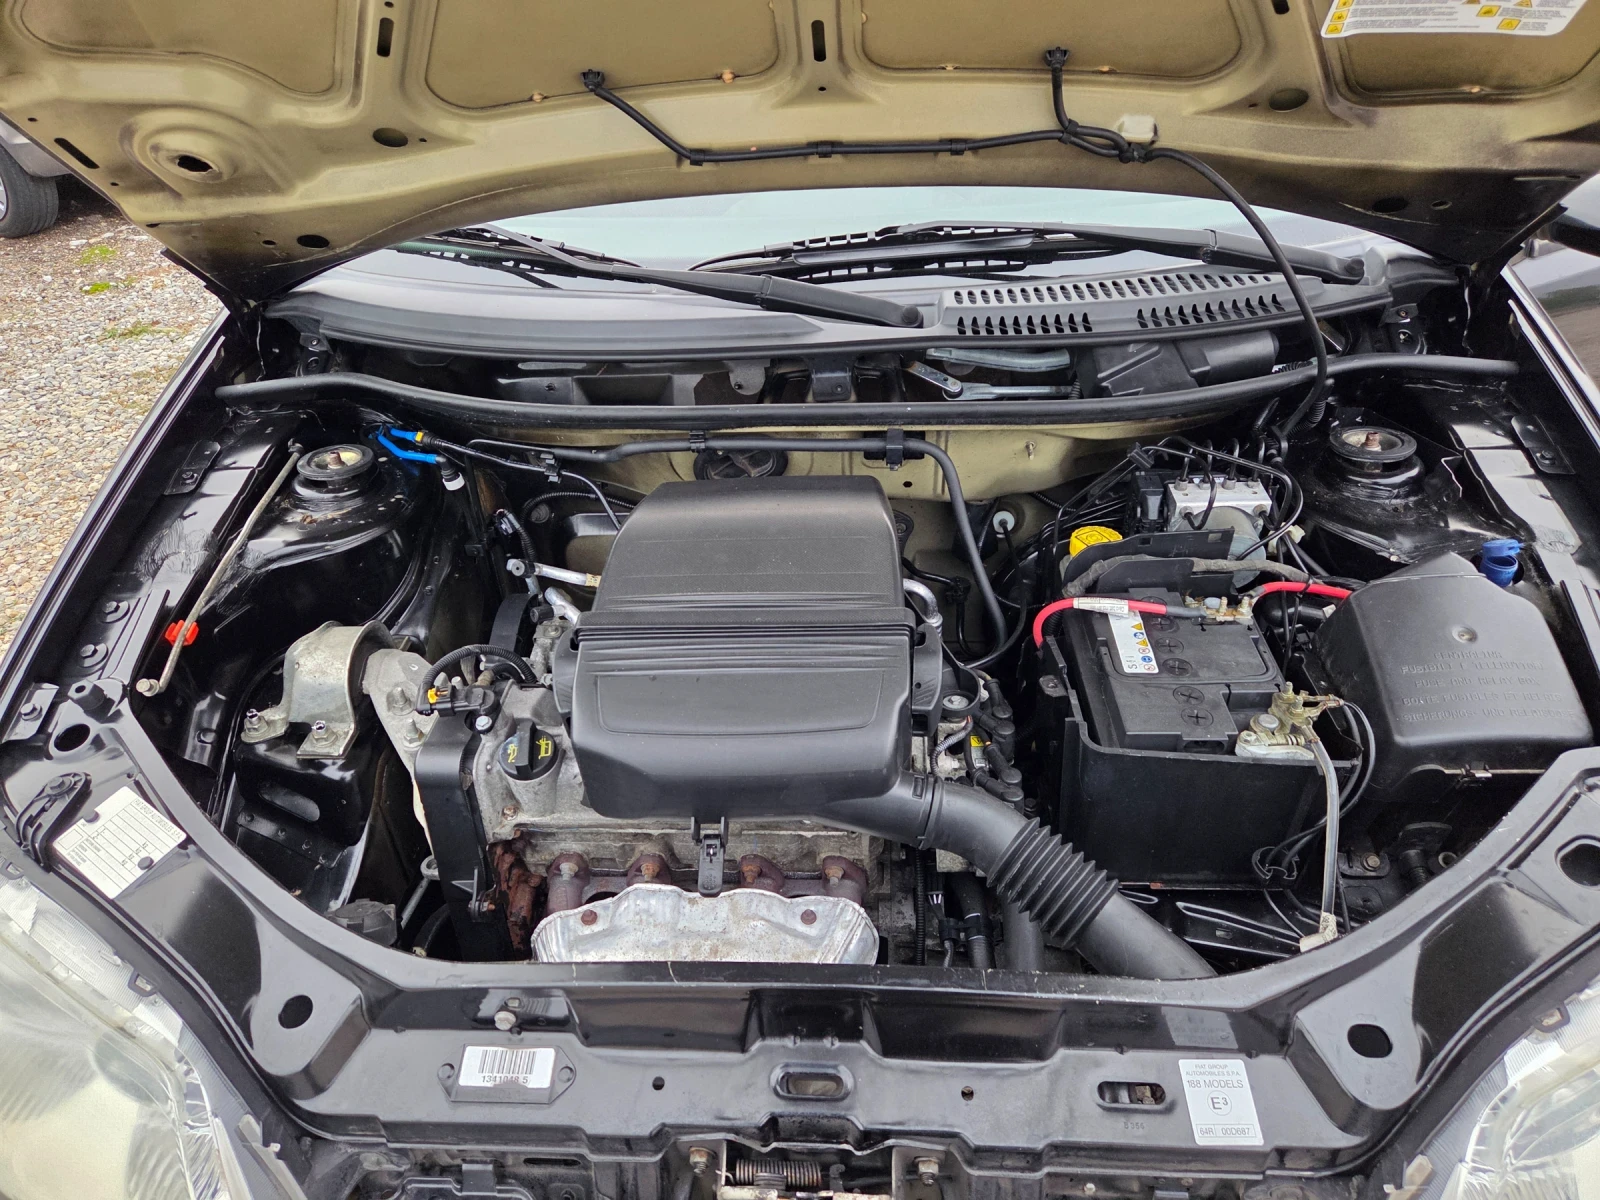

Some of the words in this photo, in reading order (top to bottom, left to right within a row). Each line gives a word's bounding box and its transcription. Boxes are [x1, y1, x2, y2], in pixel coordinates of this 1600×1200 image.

[1450, 677, 1472, 686] AND
[1518, 676, 1540, 686] BOX
[1482, 708, 1505, 717] UND
[522, 1076, 528, 1084] 5
[1187, 1080, 1201, 1088] 188
[1204, 1080, 1244, 1088] MODELS
